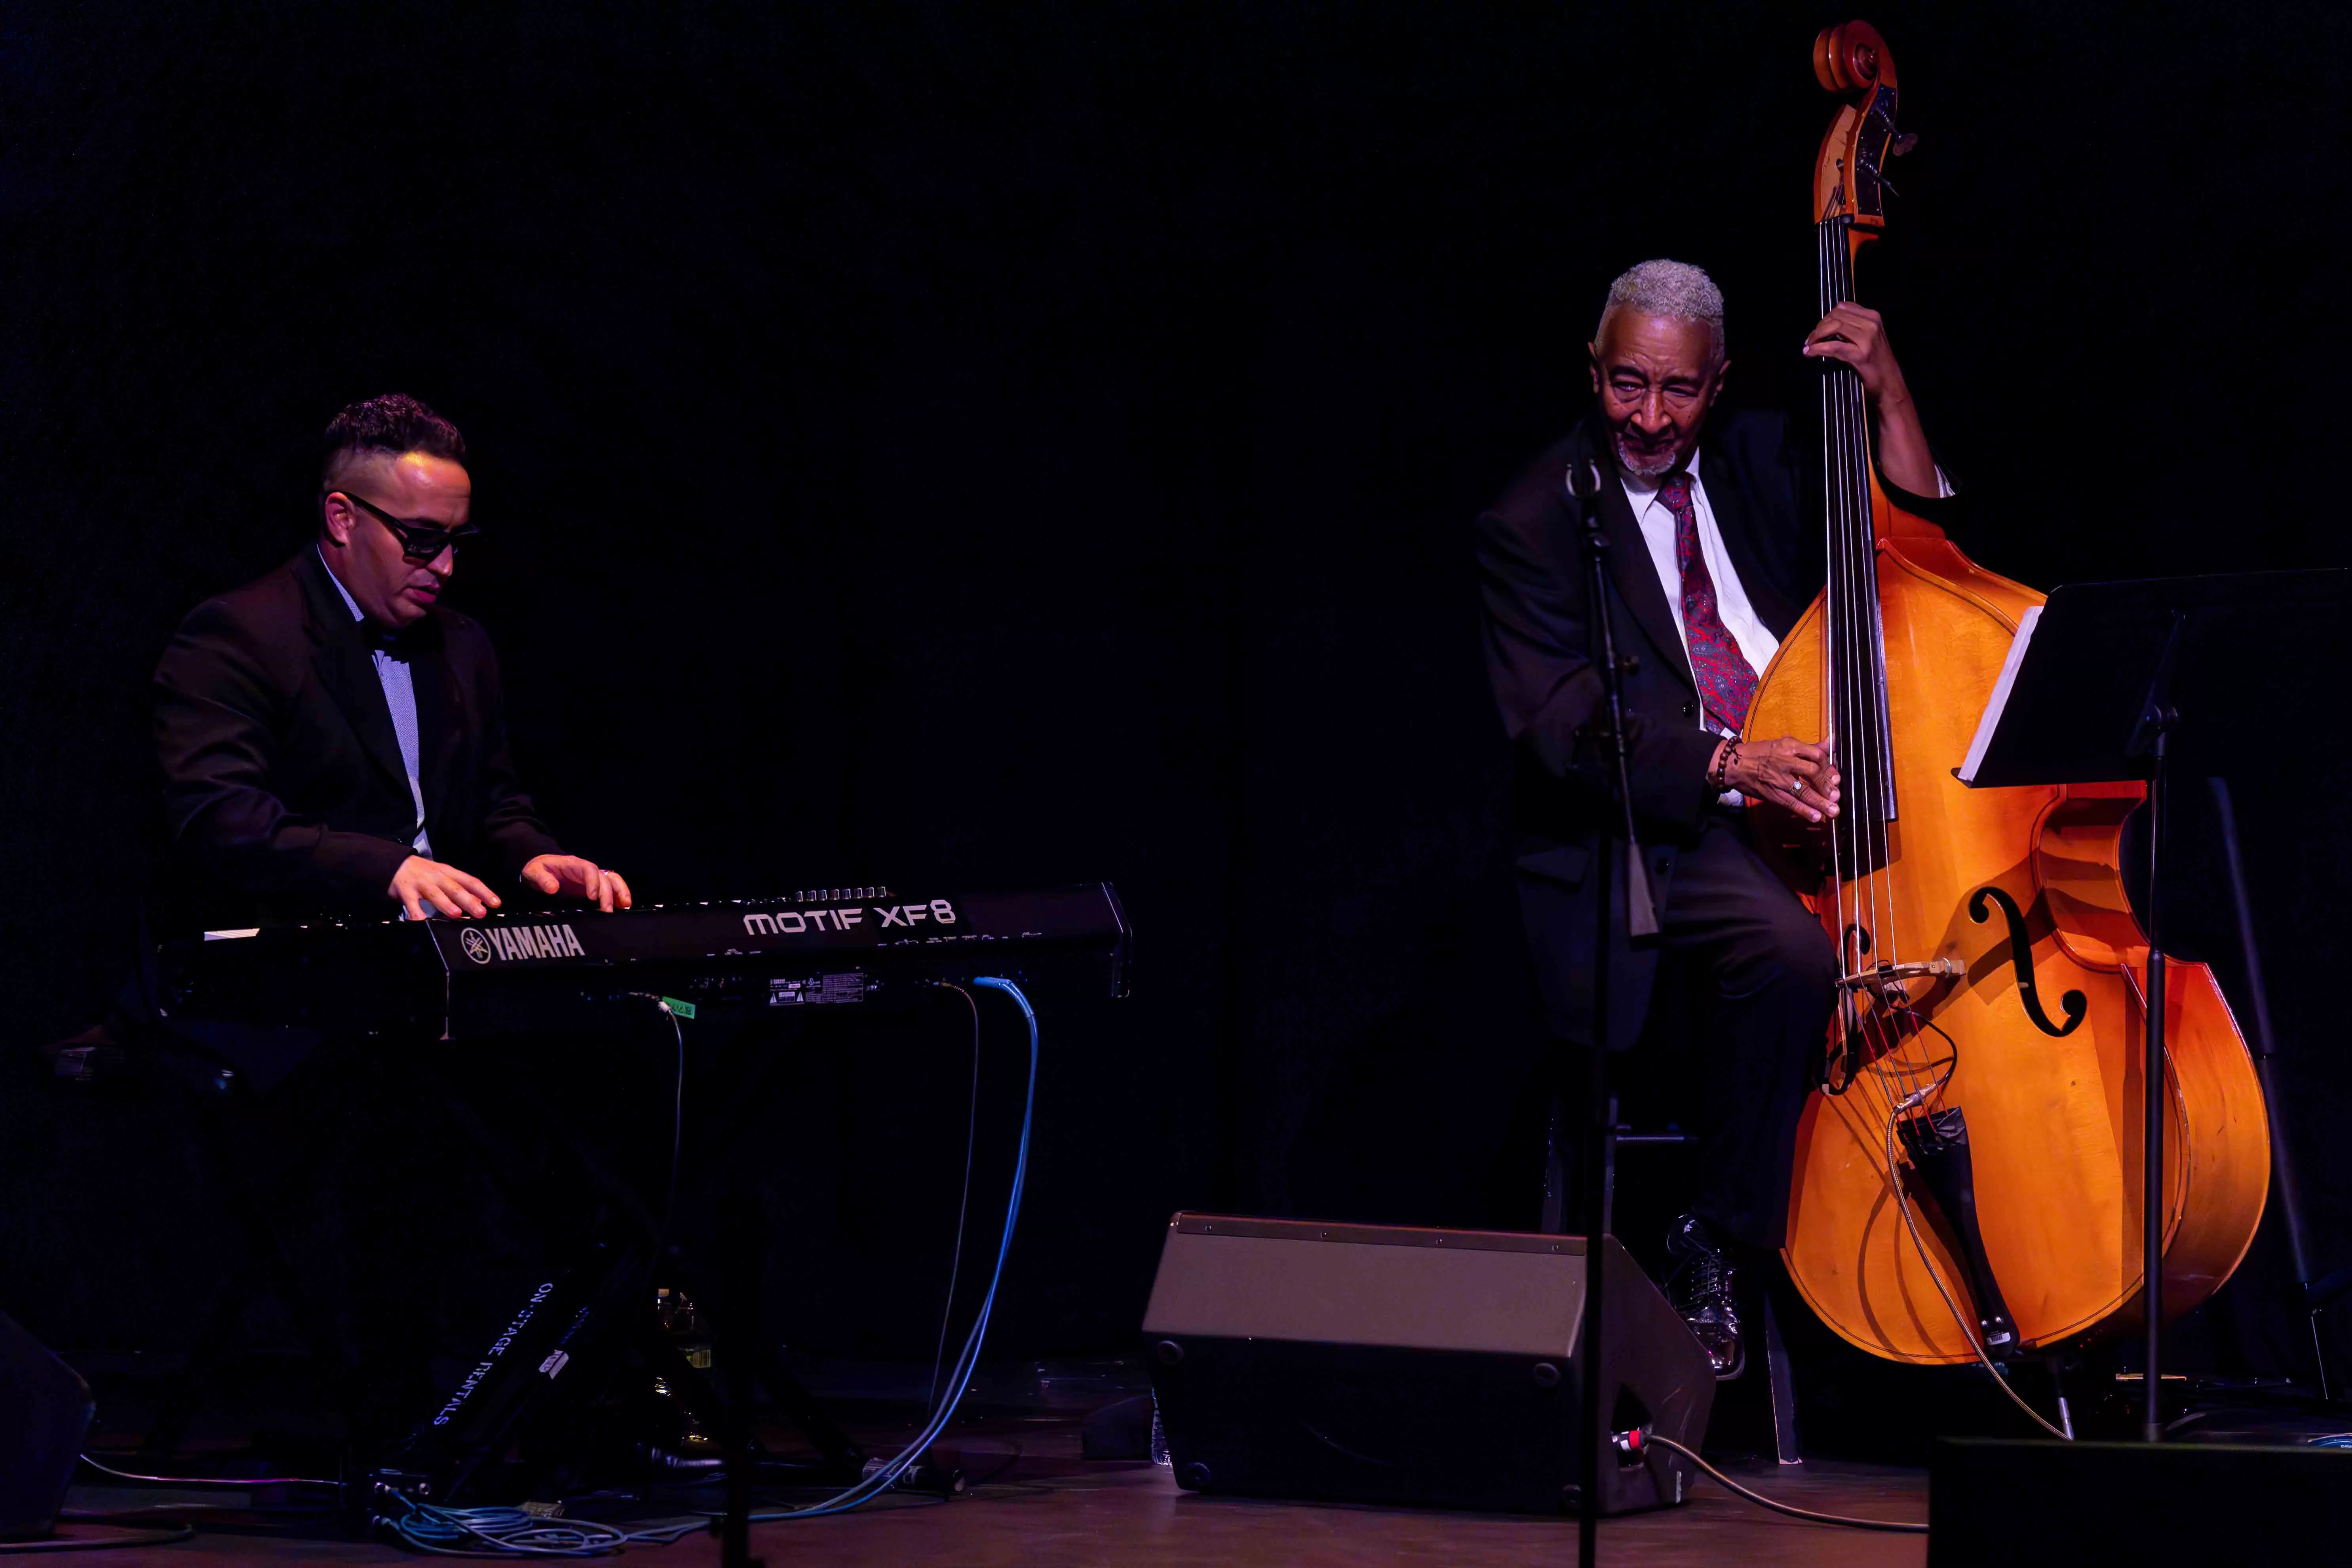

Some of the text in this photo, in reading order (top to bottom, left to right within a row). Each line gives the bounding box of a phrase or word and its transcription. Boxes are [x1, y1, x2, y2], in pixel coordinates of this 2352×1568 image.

[743, 899, 956, 935] MOTIF XF8
[485, 924, 586, 961] YAMAHA
[434, 1362, 494, 1425] RENTALS
